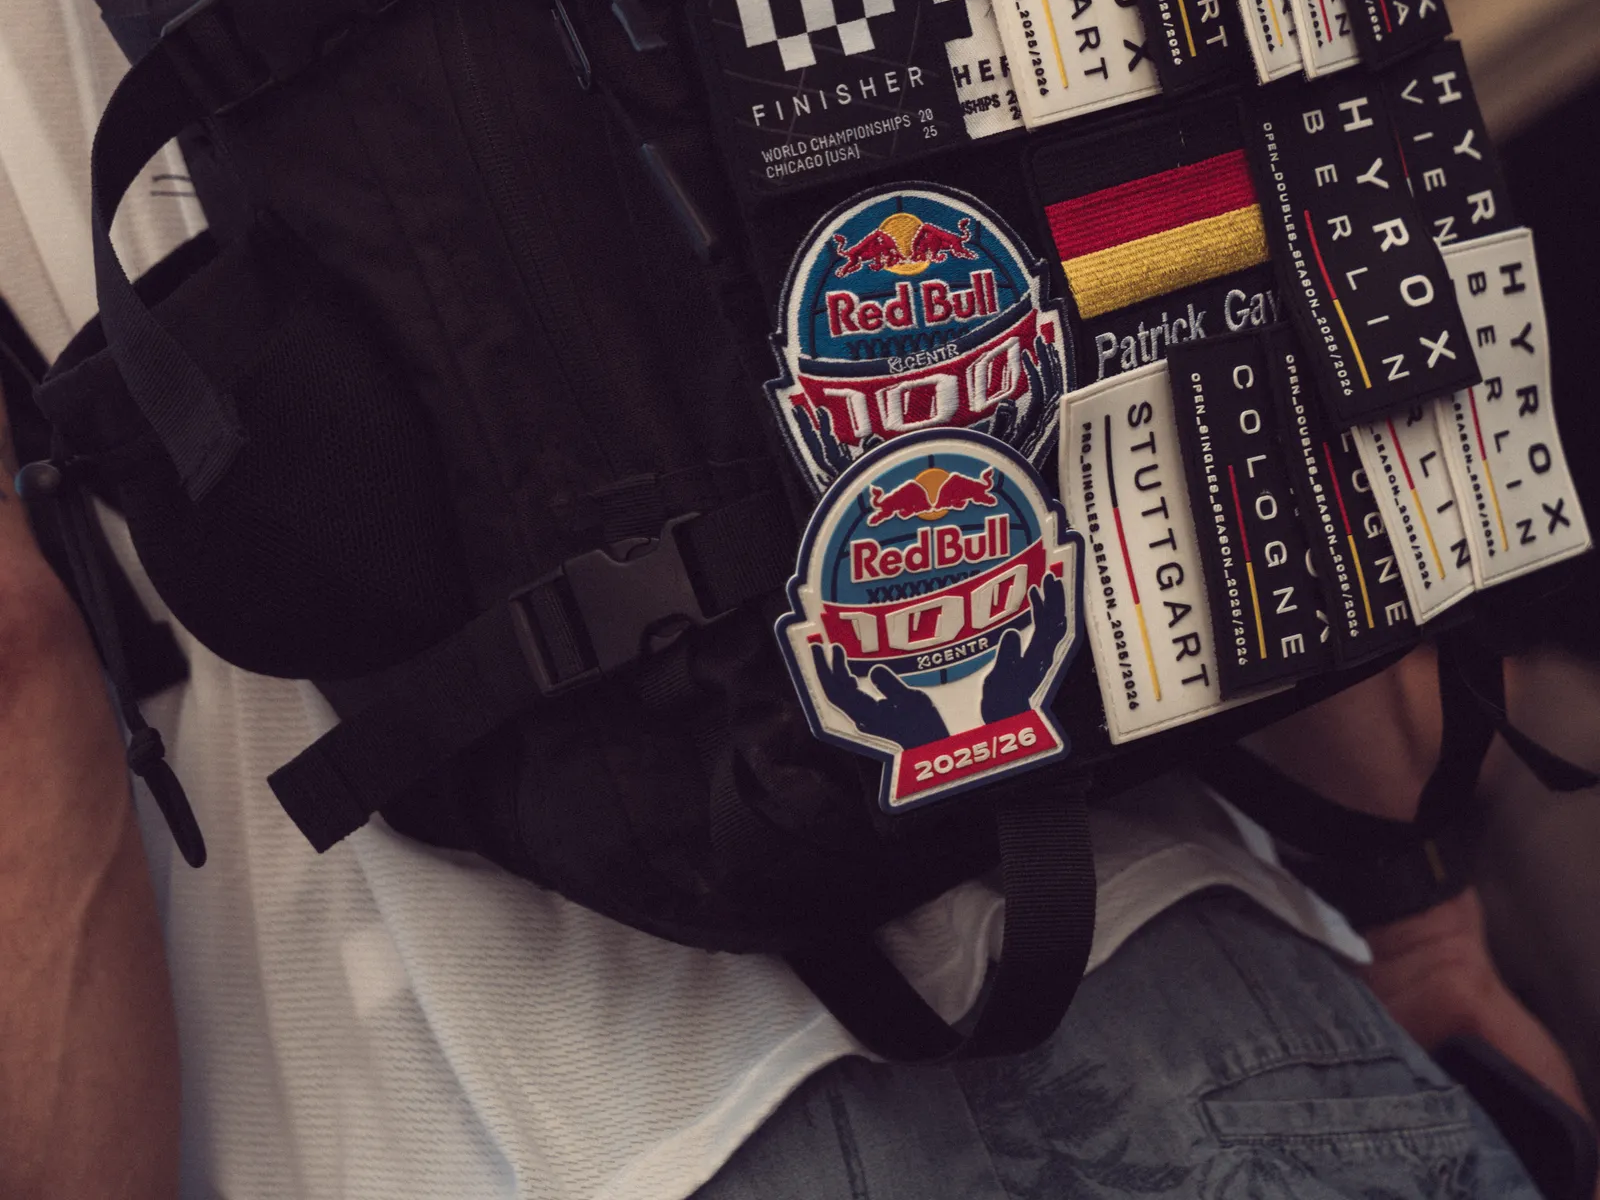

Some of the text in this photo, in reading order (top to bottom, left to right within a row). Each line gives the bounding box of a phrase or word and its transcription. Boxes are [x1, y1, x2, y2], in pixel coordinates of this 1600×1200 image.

[752, 66, 924, 126] FINISHER
[761, 108, 933, 163] WORLD CHAMPIONSHIPS 20
[766, 125, 938, 178] CHICAGO [USA] 25
[1303, 110, 1410, 381] BERLIN
[1339, 97, 1456, 368] HYROX
[824, 268, 998, 339] Red Bull
[1094, 303, 1206, 381] Patrick
[822, 335, 1019, 438] 100
[1467, 271, 1536, 546] BERLIN
[1499, 262, 1570, 534] HYROX
[849, 513, 1011, 584] Red Bull
[1127, 401, 1211, 688] STUTTGART
[1233, 365, 1305, 658] COLOGNE
[838, 563, 1028, 654] 100
[932, 637, 990, 666] CENTR
[913, 726, 1038, 783] 2025/26
